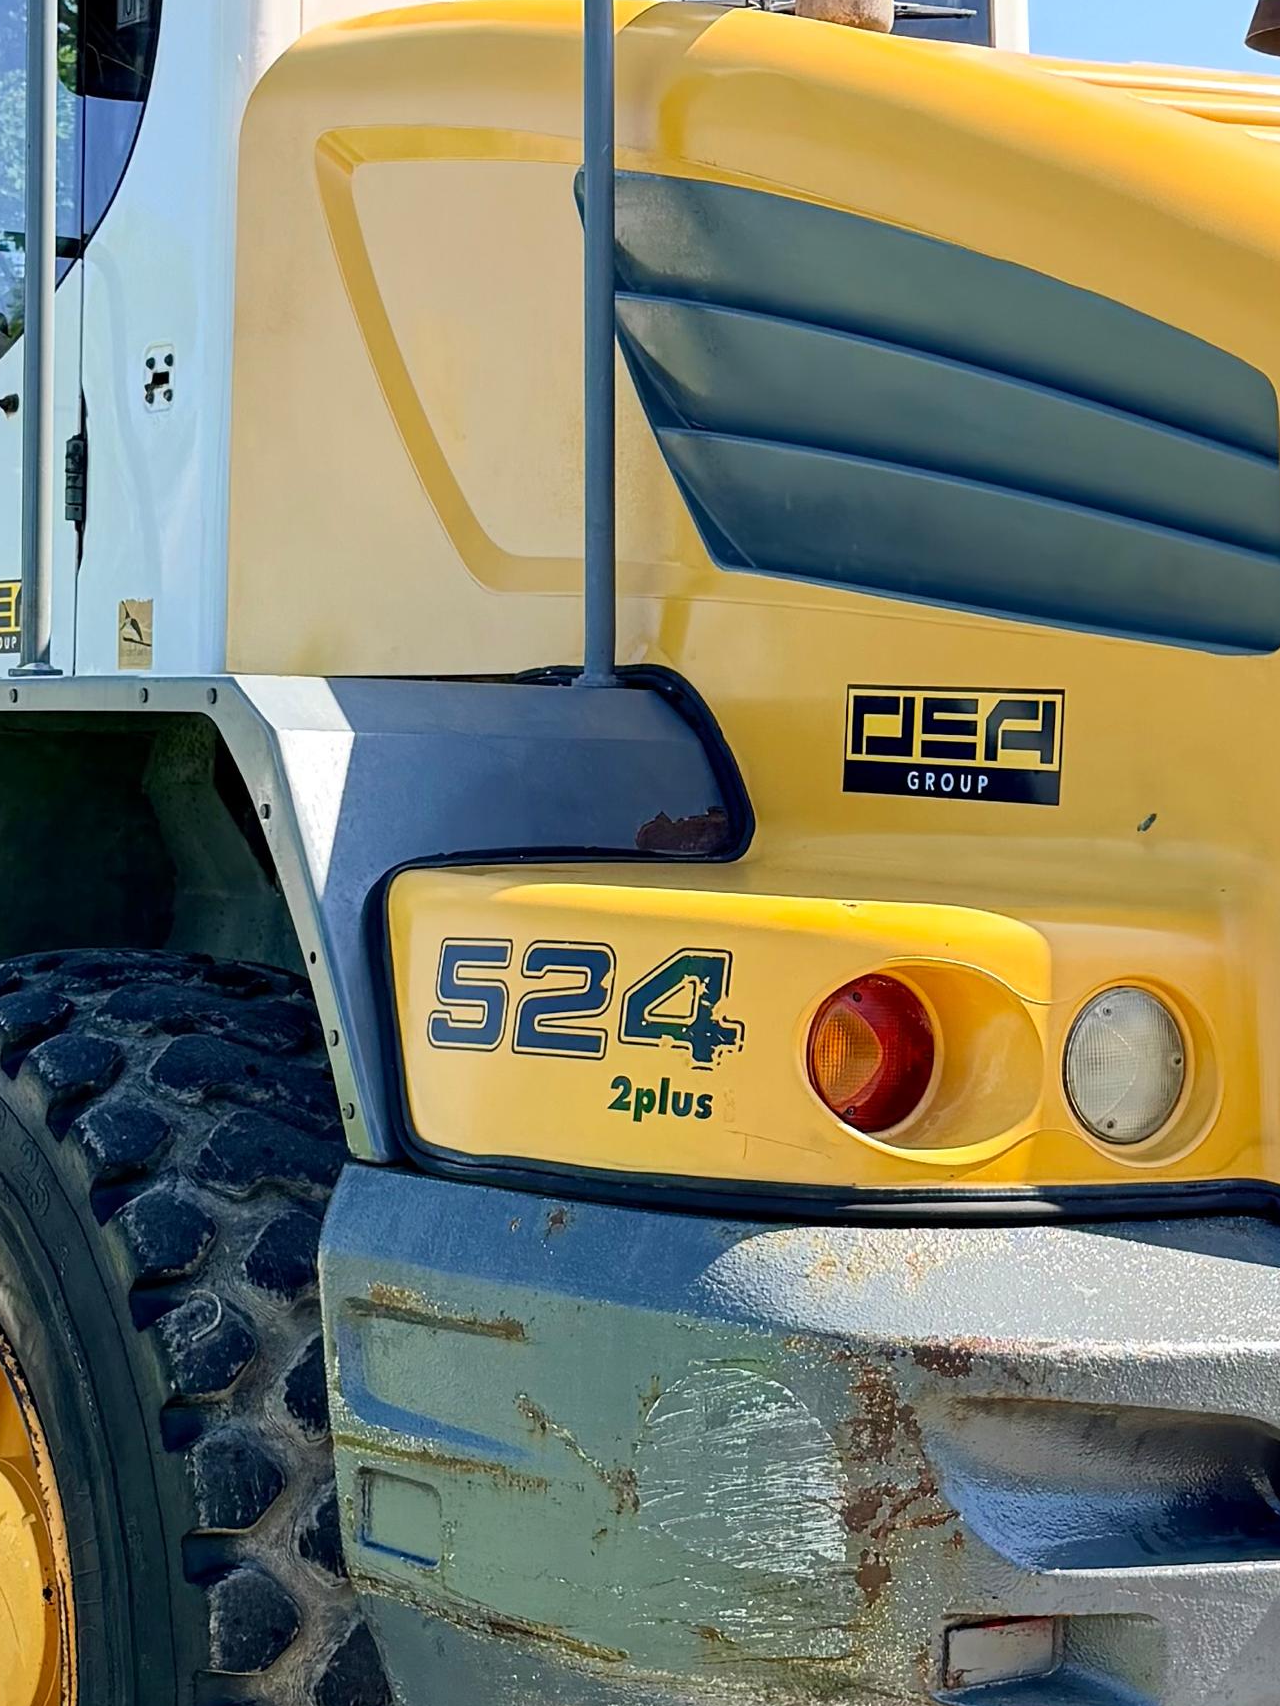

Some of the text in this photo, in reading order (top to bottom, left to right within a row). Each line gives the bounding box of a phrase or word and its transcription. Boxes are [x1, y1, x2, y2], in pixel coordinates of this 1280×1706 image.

[906, 770, 990, 794] GROUP
[426, 936, 746, 1071] 524
[607, 1075, 715, 1123] 2plus
[10, 1138, 51, 1218] 25
